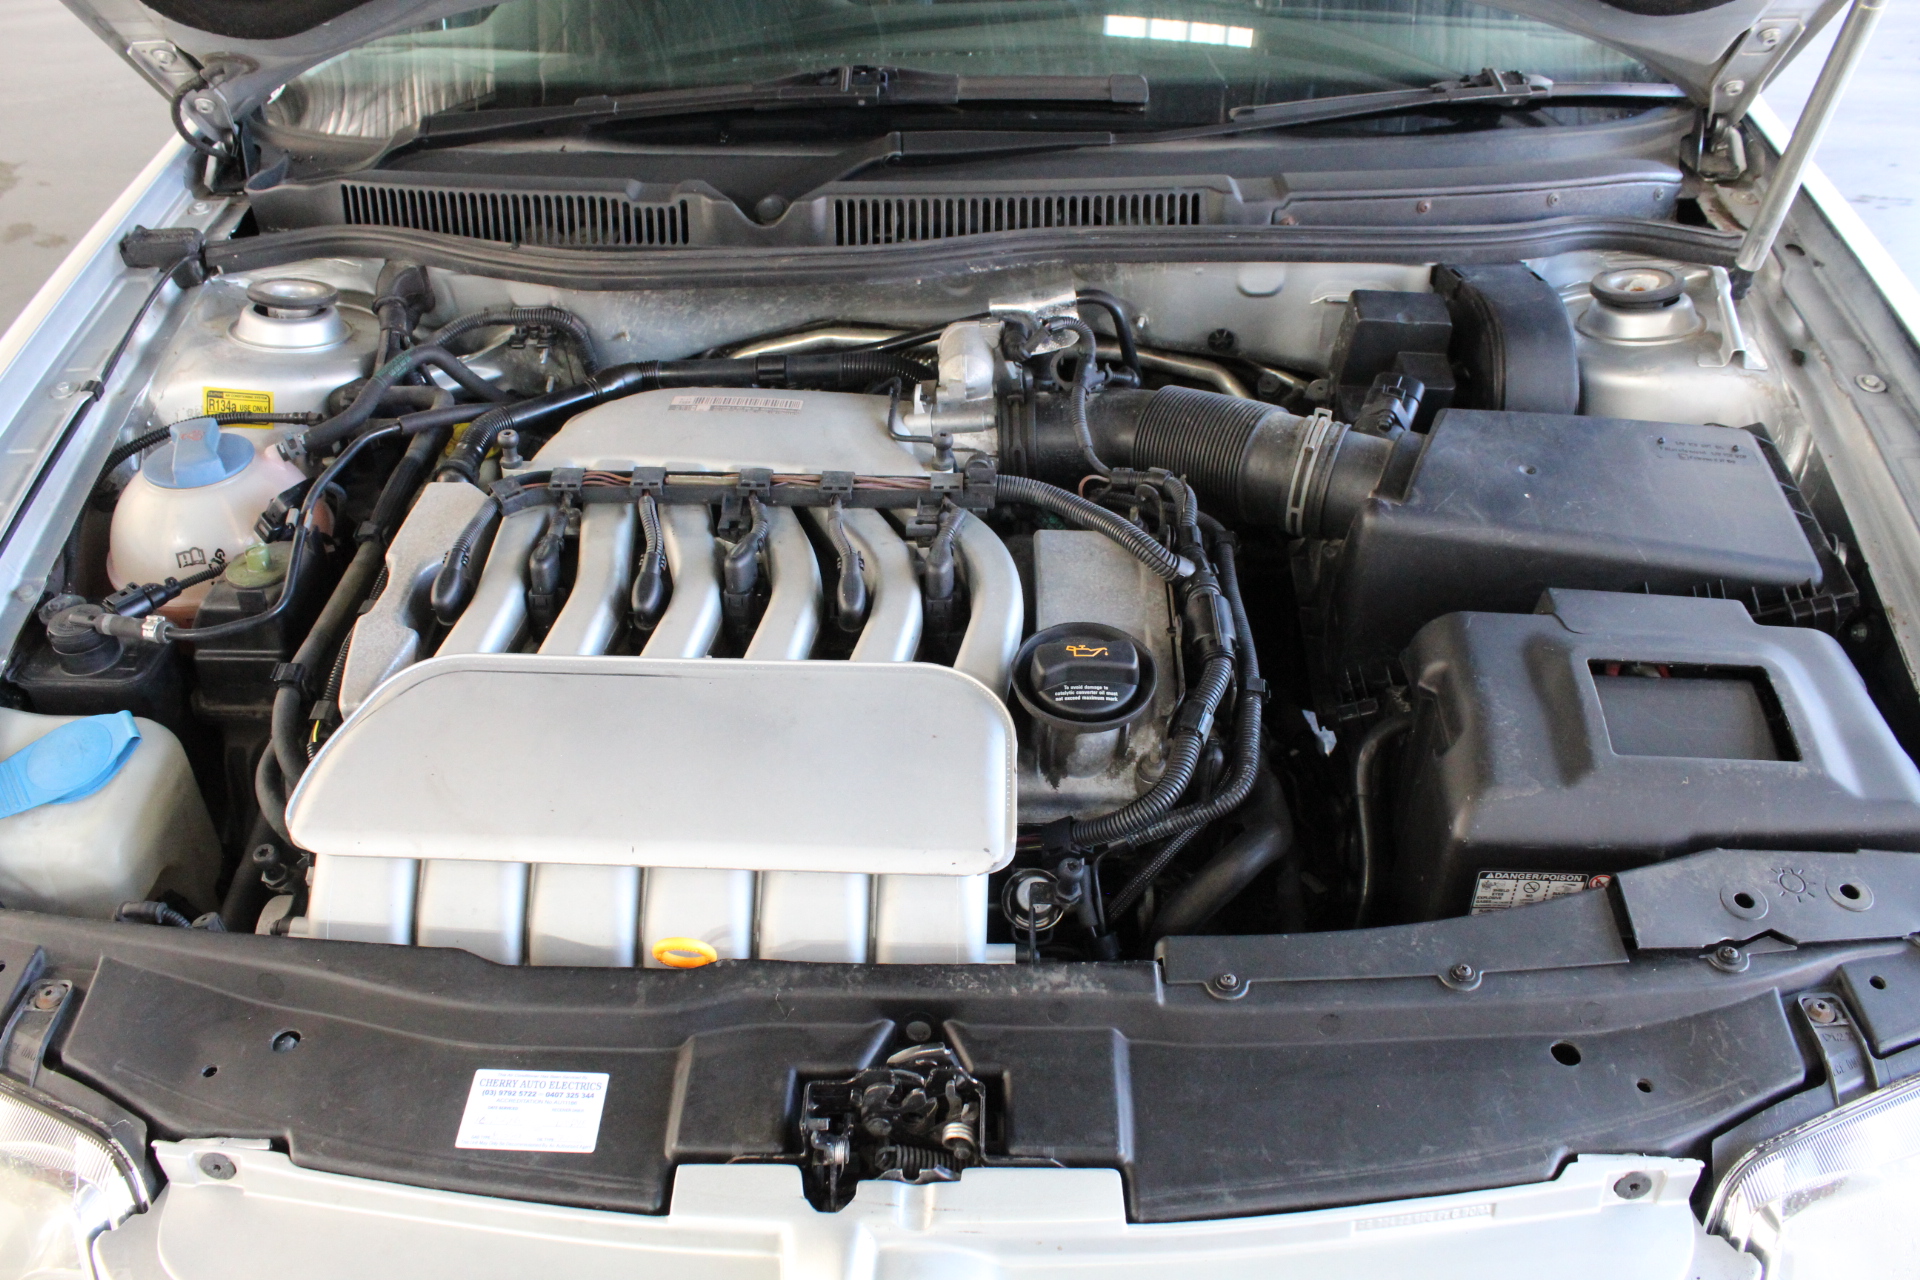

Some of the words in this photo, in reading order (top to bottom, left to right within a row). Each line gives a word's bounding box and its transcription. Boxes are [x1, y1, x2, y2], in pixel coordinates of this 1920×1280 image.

[208, 399, 236, 412] R134a
[239, 404, 251, 412] USE
[252, 405, 268, 413] ONLY
[1494, 872, 1583, 881] DANGER/POISON
[479, 1078, 518, 1088] CHERRY
[520, 1080, 546, 1089] AUTO
[548, 1081, 602, 1091] ELECTRICS
